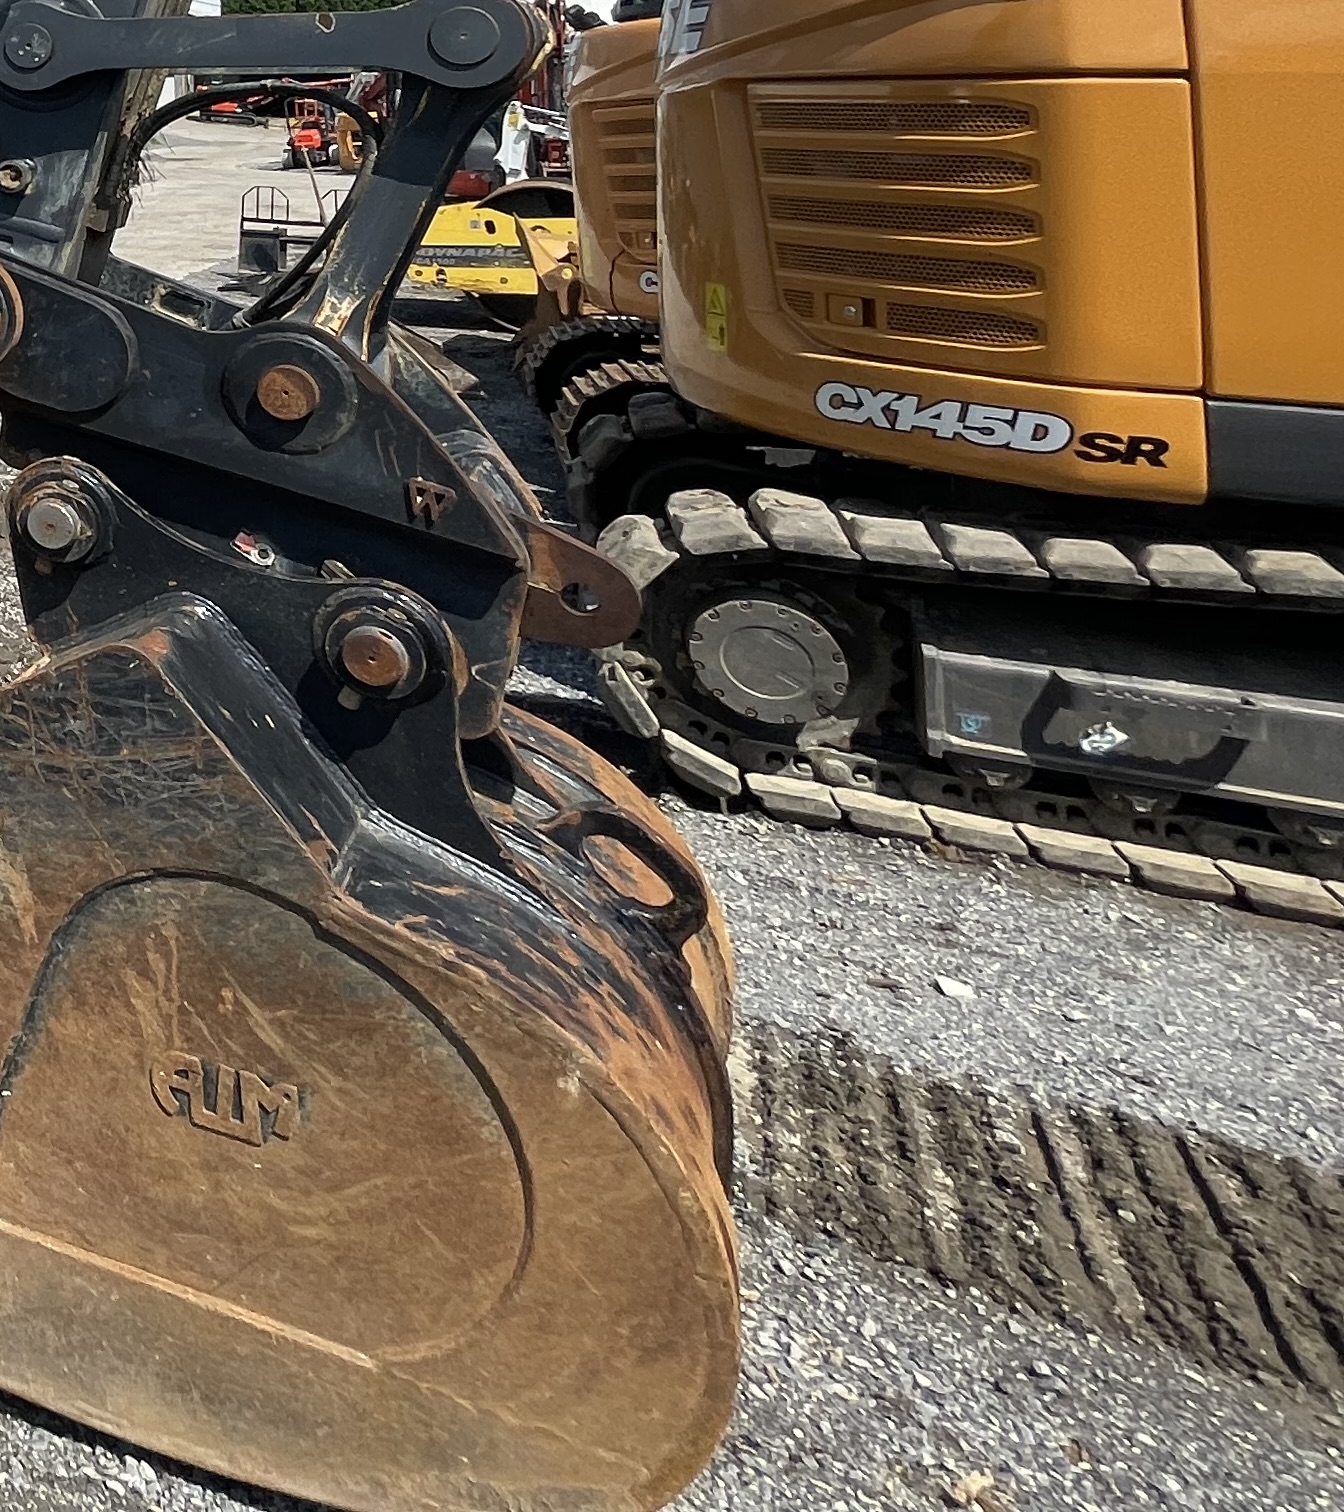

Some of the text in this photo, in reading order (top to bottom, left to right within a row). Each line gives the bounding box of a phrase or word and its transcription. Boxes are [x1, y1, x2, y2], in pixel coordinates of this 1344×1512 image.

[416, 246, 527, 257] DYNAPAC
[815, 382, 1168, 468] CX145D SR
